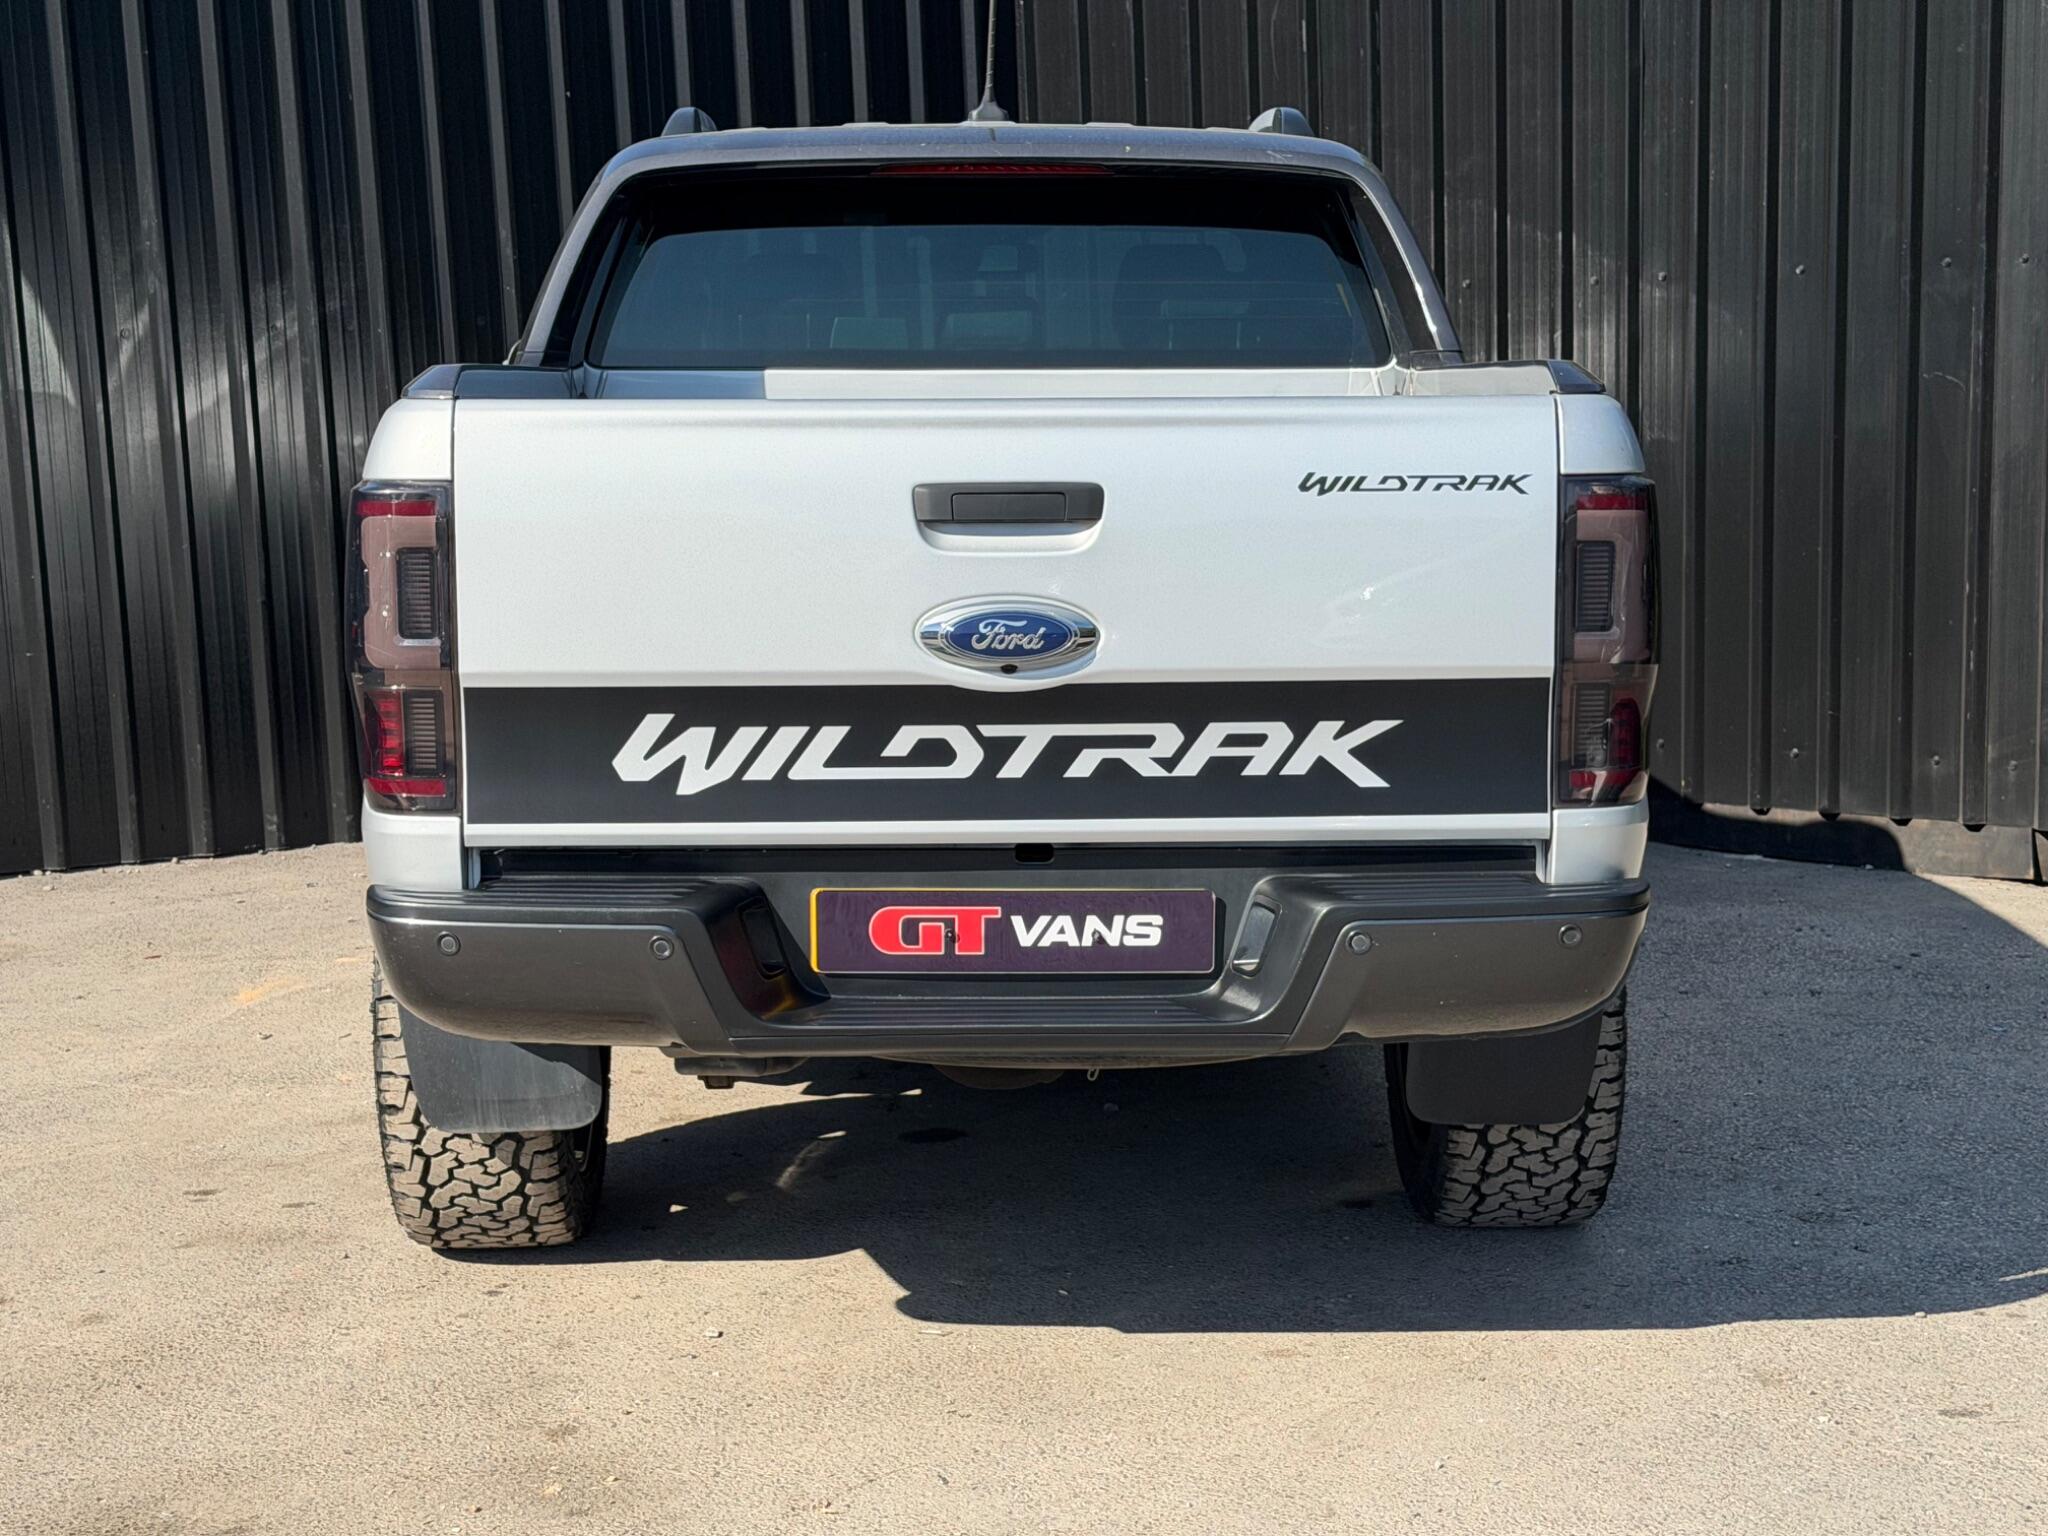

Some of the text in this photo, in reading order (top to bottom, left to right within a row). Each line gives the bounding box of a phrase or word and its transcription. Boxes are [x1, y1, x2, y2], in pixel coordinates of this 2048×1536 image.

[1298, 472, 1533, 496] WILDTRAK
[971, 618, 1047, 651] Ford
[611, 712, 1404, 796] WILDTRAK
[868, 905, 1164, 955] GT VANS
